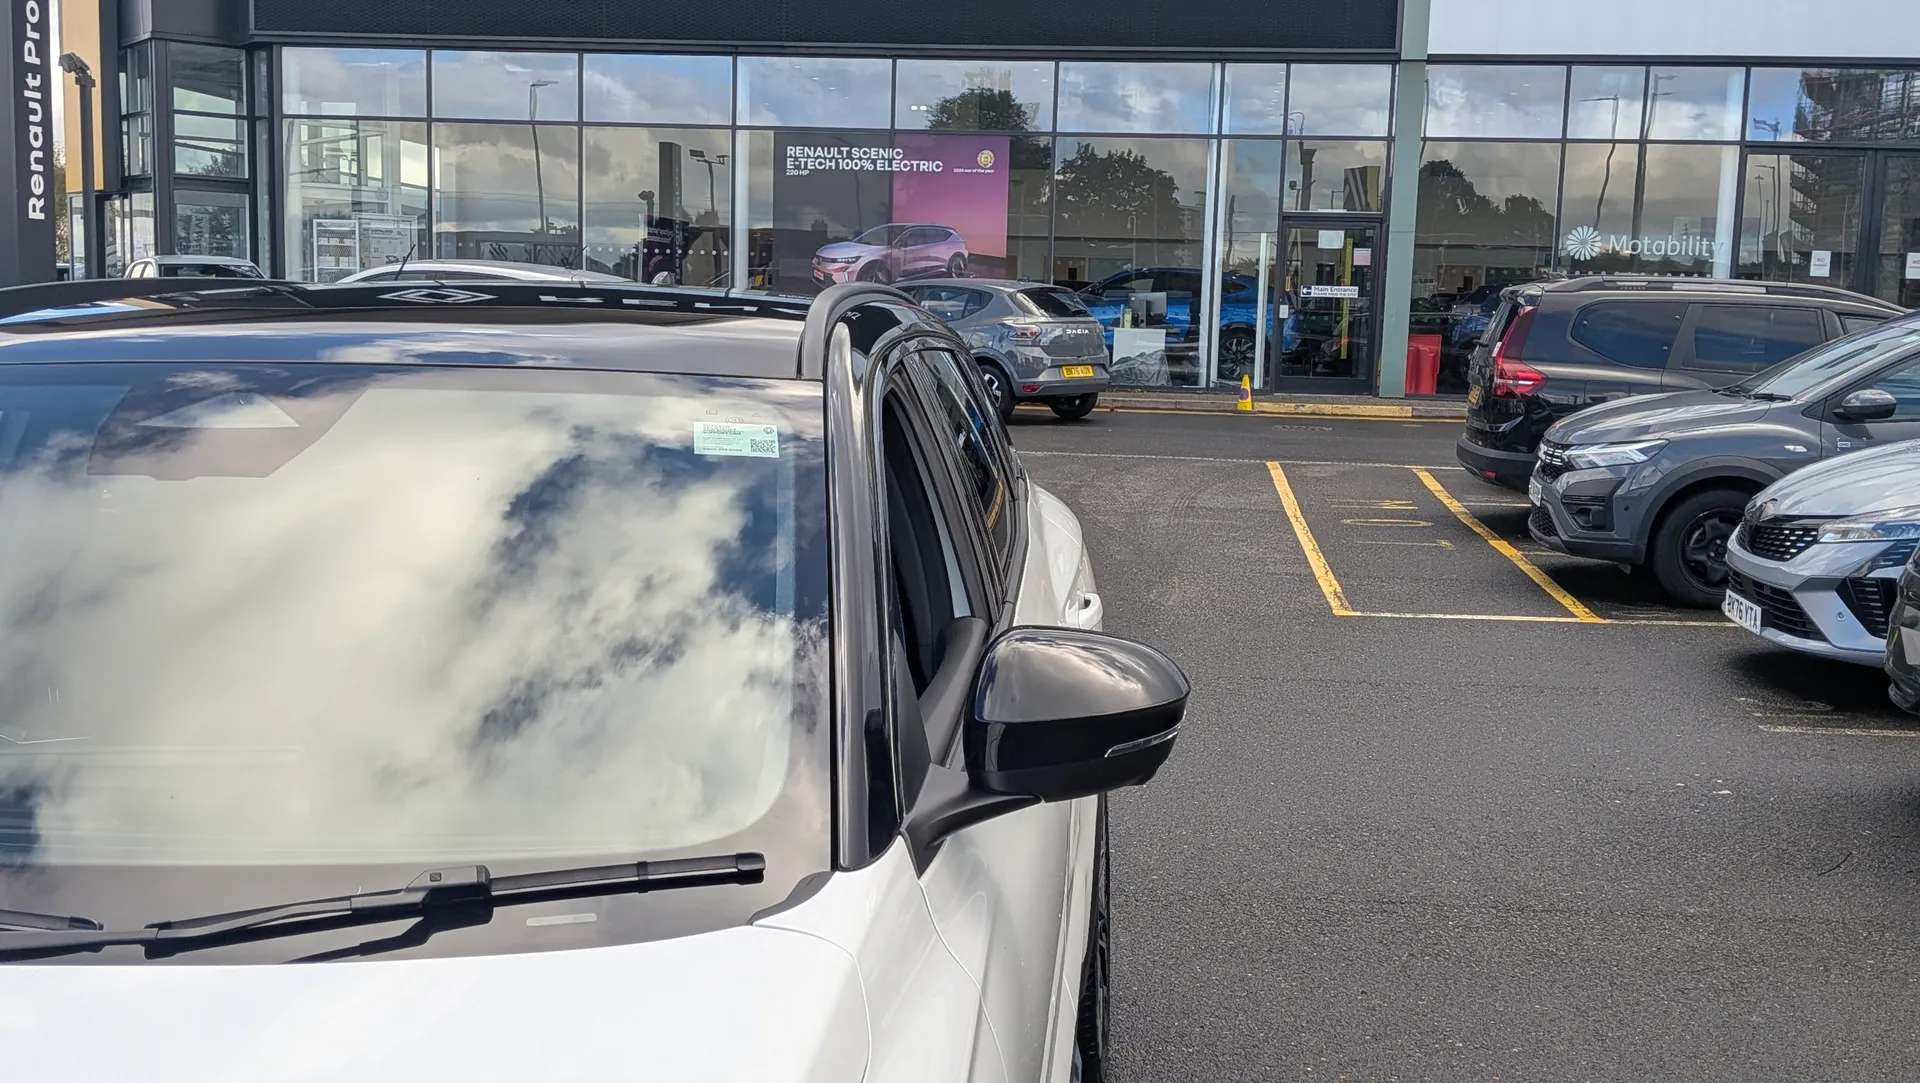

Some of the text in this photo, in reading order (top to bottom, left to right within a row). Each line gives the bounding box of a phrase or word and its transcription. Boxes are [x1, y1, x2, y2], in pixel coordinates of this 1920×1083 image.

[24, 0, 45, 220] Renault Pro
[786, 146, 904, 160] RENAULT SCENIC
[786, 158, 944, 172] E-TECH 100% ELECTRIC
[1608, 235, 1726, 262] Motability
